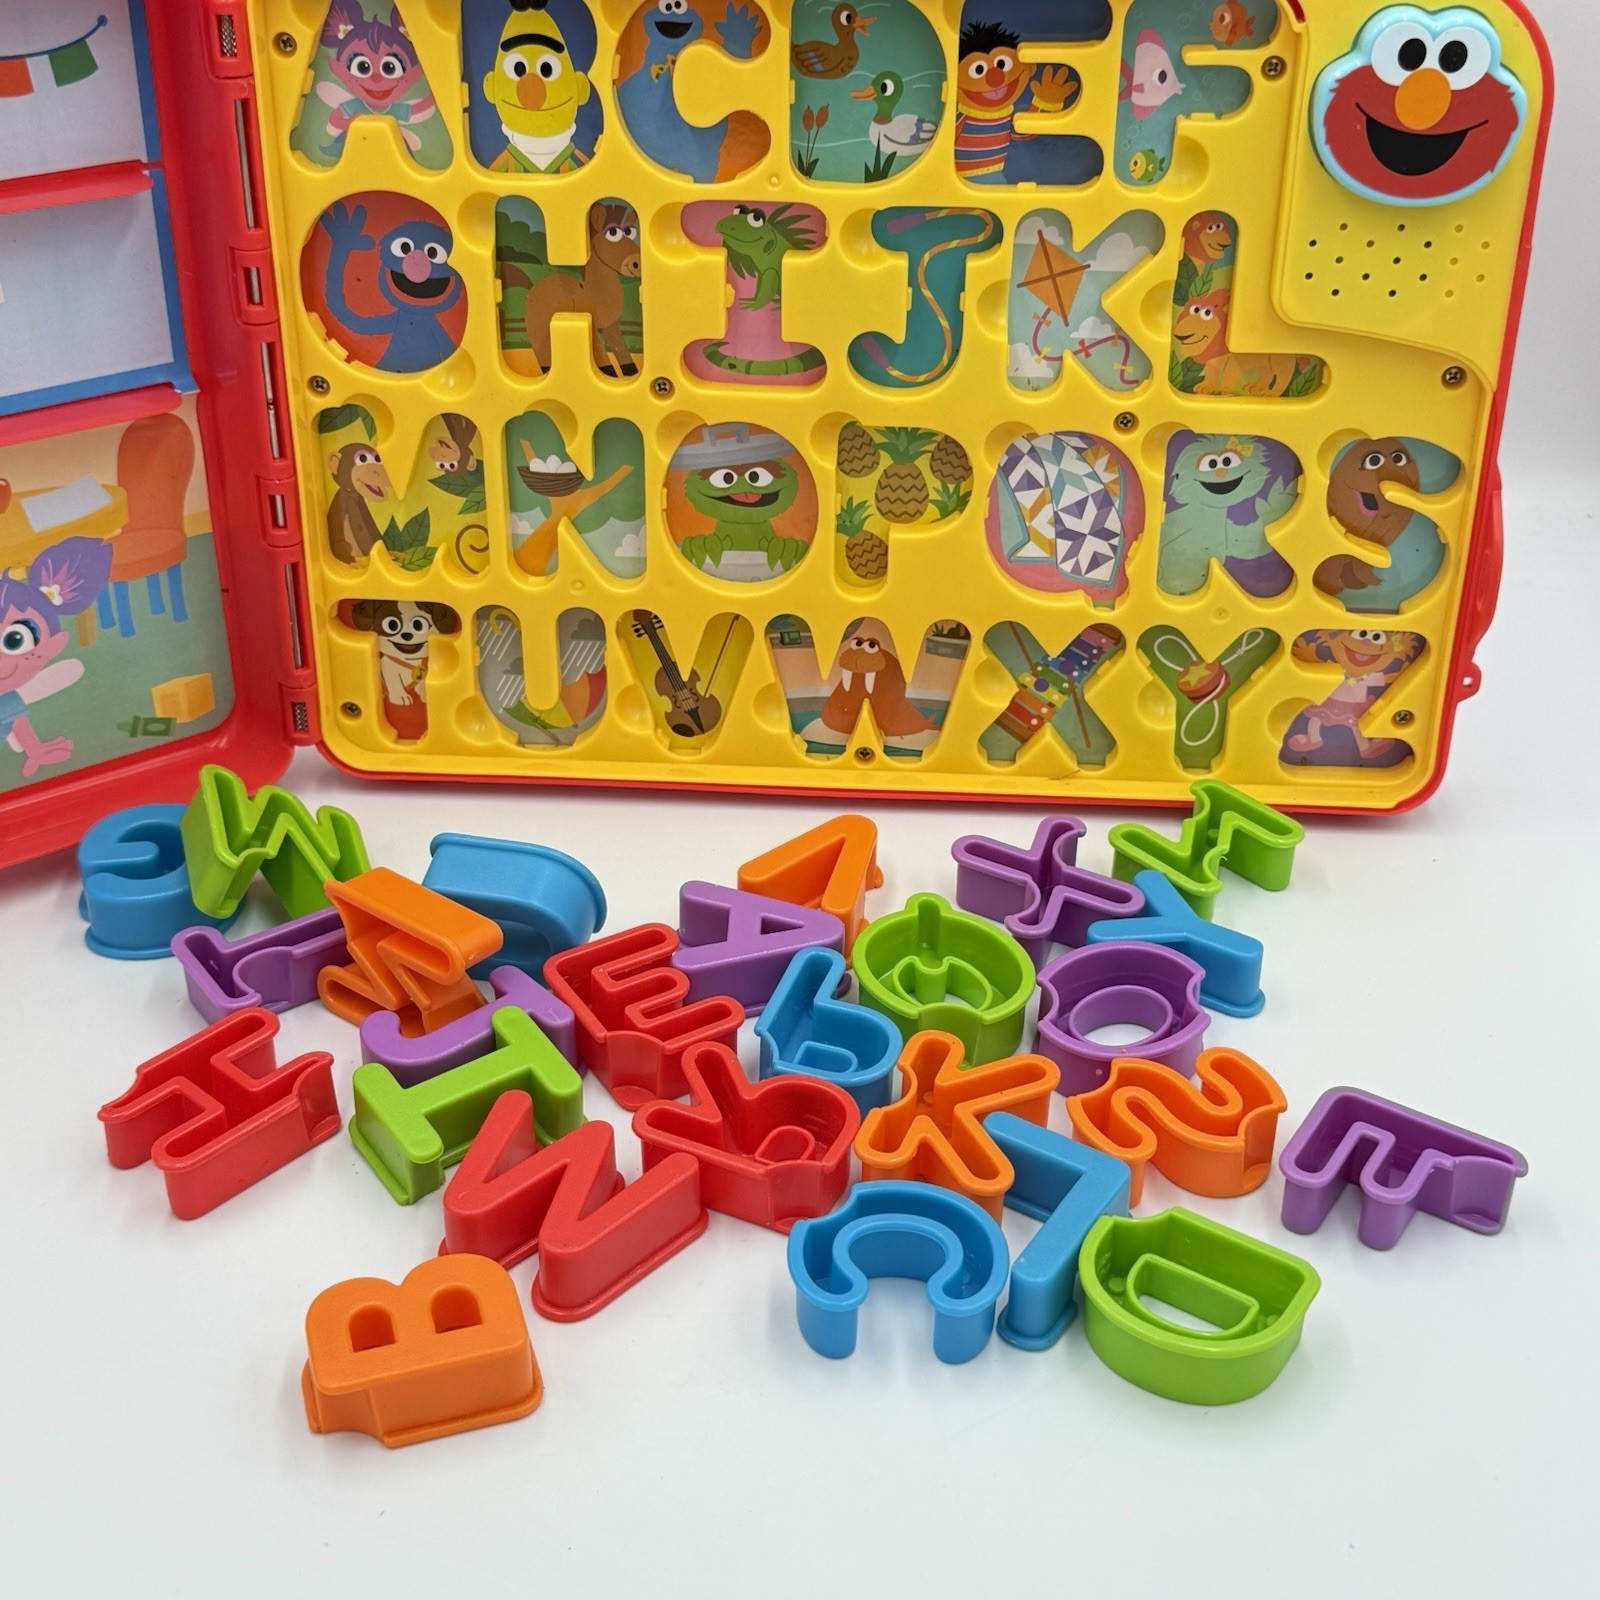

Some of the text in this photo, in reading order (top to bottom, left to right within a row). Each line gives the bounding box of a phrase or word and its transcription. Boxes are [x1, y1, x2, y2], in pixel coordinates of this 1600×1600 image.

[288, 0, 1282, 190] A B C D E F
[300, 188, 1328, 400] G H I J K L
[315, 402, 1464, 616] M N O P Q R S
[335, 599, 1431, 772] T U V W X Y Z
[668, 880, 845, 1012] A
[952, 815, 1144, 955] X
[1087, 870, 1265, 1012] Y
[350, 1005, 584, 1204] I
[360, 965, 584, 1078] J
[543, 923, 744, 1105] E
[1036, 941, 1211, 1085] O
[97, 1008, 341, 1220] H
[854, 1030, 1060, 1215] K
[787, 1180, 1010, 1364] C
[982, 1111, 1131, 1351] L
[1079, 1206, 1322, 1405] D
[301, 1252, 543, 1448] B
